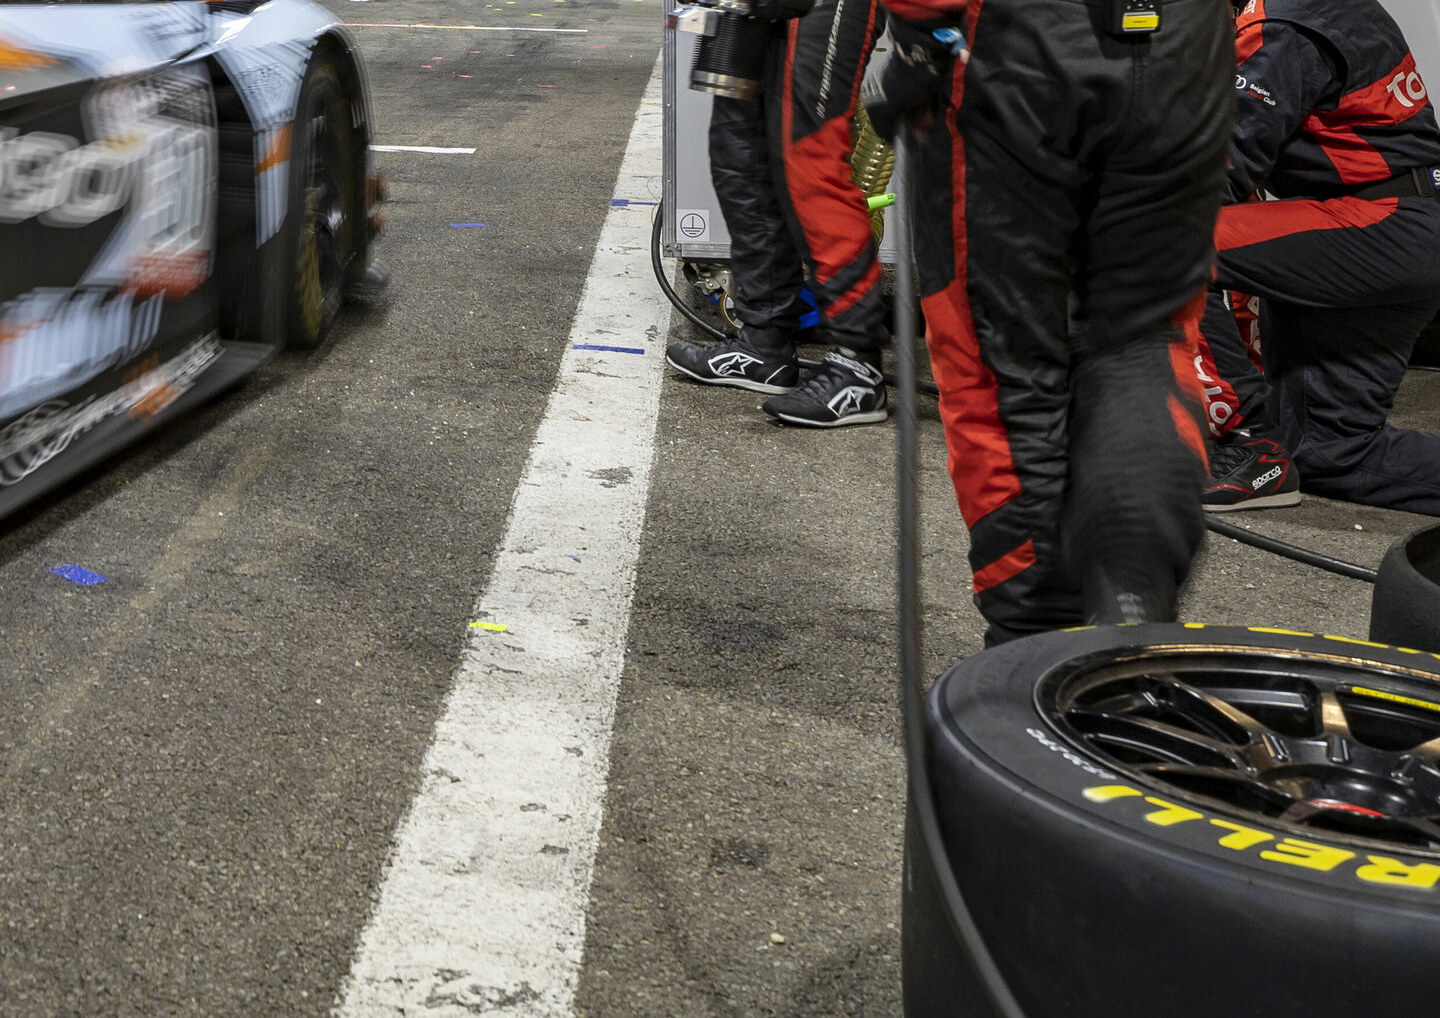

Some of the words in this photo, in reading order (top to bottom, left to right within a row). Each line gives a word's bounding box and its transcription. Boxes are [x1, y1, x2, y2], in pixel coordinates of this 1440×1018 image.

[1250, 83, 1271, 97] Belgian
[1263, 96, 1276, 106] Club
[1252, 465, 1283, 490] sparco
